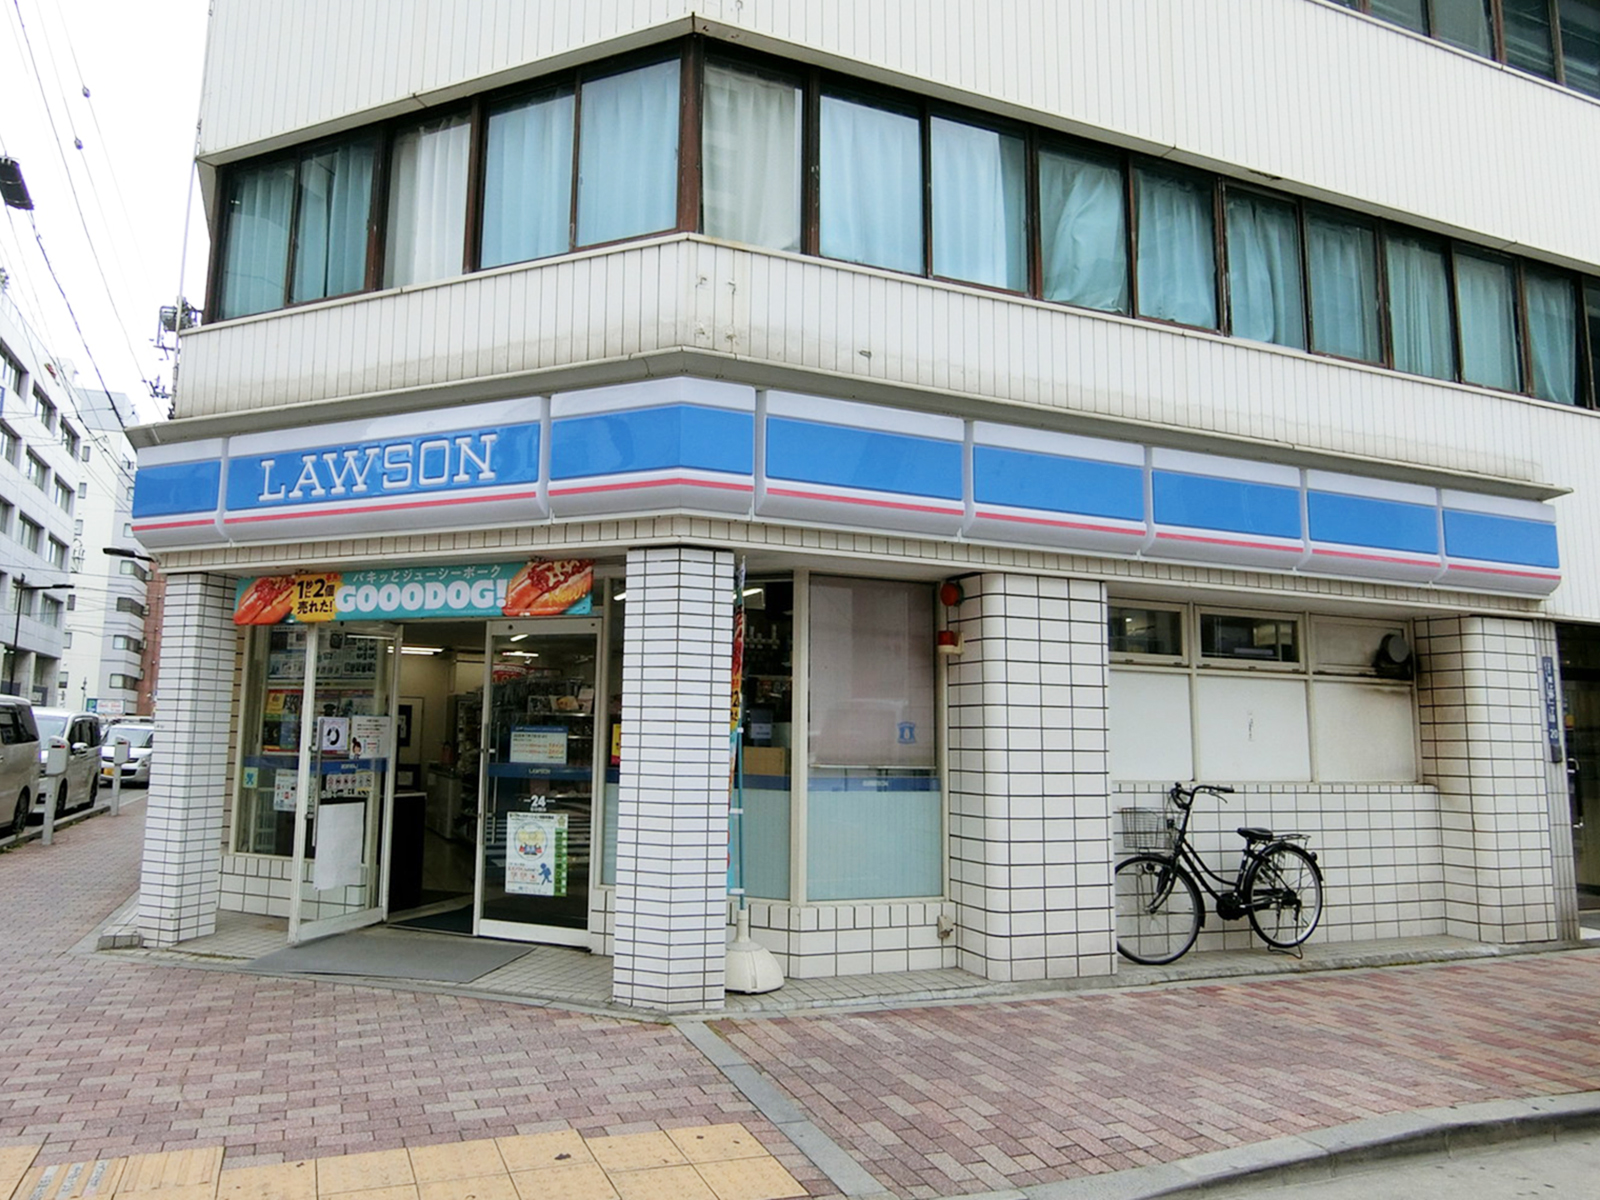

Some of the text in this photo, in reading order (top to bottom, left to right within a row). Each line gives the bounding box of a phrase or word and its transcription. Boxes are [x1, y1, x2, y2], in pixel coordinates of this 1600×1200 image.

[259, 433, 497, 501] LAWSON
[336, 579, 508, 613] GOOODOG!
[530, 794, 547, 807] 24
